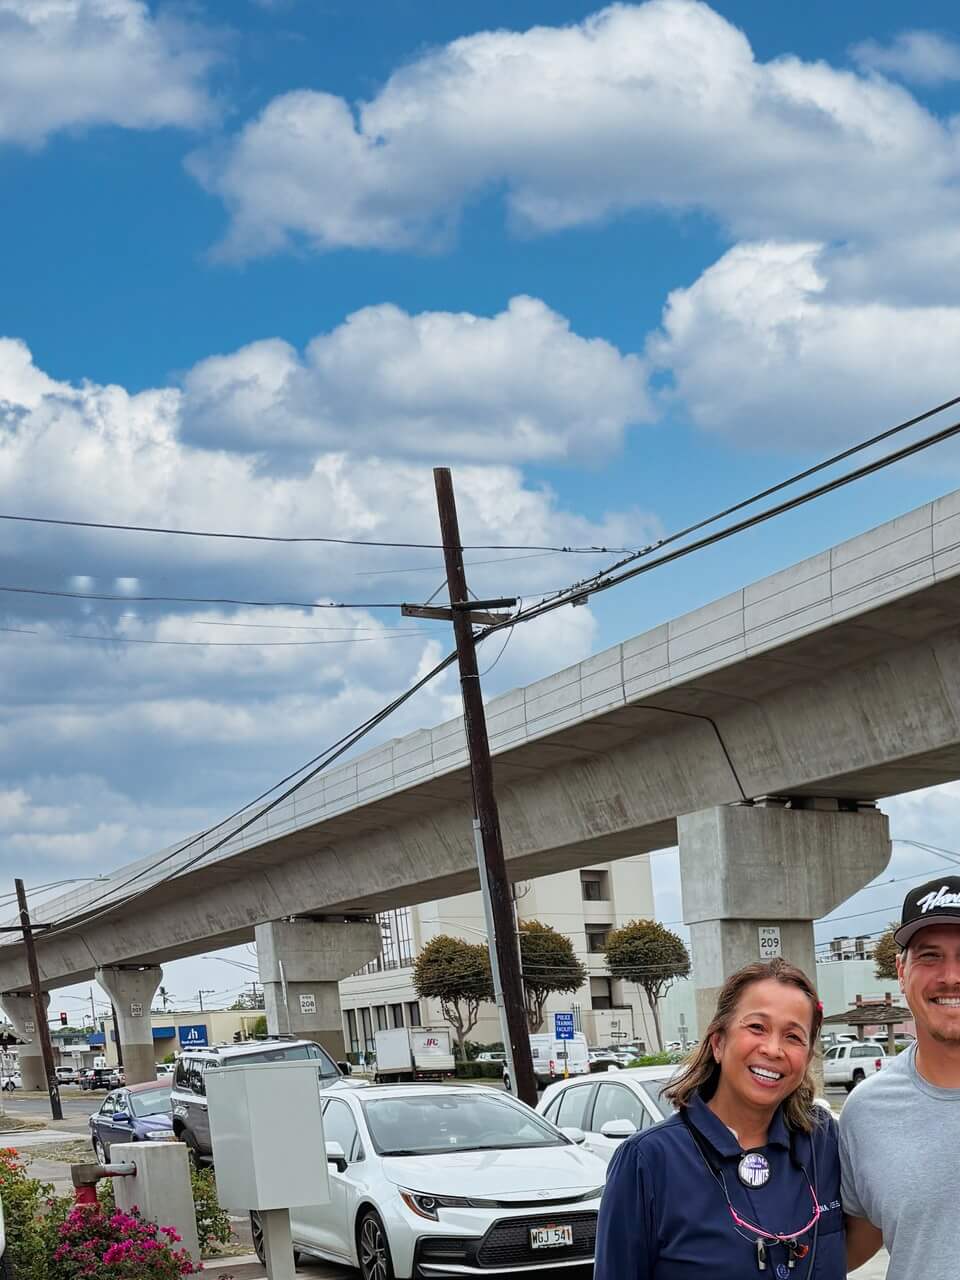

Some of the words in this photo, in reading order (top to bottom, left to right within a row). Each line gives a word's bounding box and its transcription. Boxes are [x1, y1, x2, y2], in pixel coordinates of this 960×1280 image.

[761, 937, 779, 948] 209
[740, 1166, 770, 1186] IMPLANTS
[554, 1229, 570, 1241] 541
